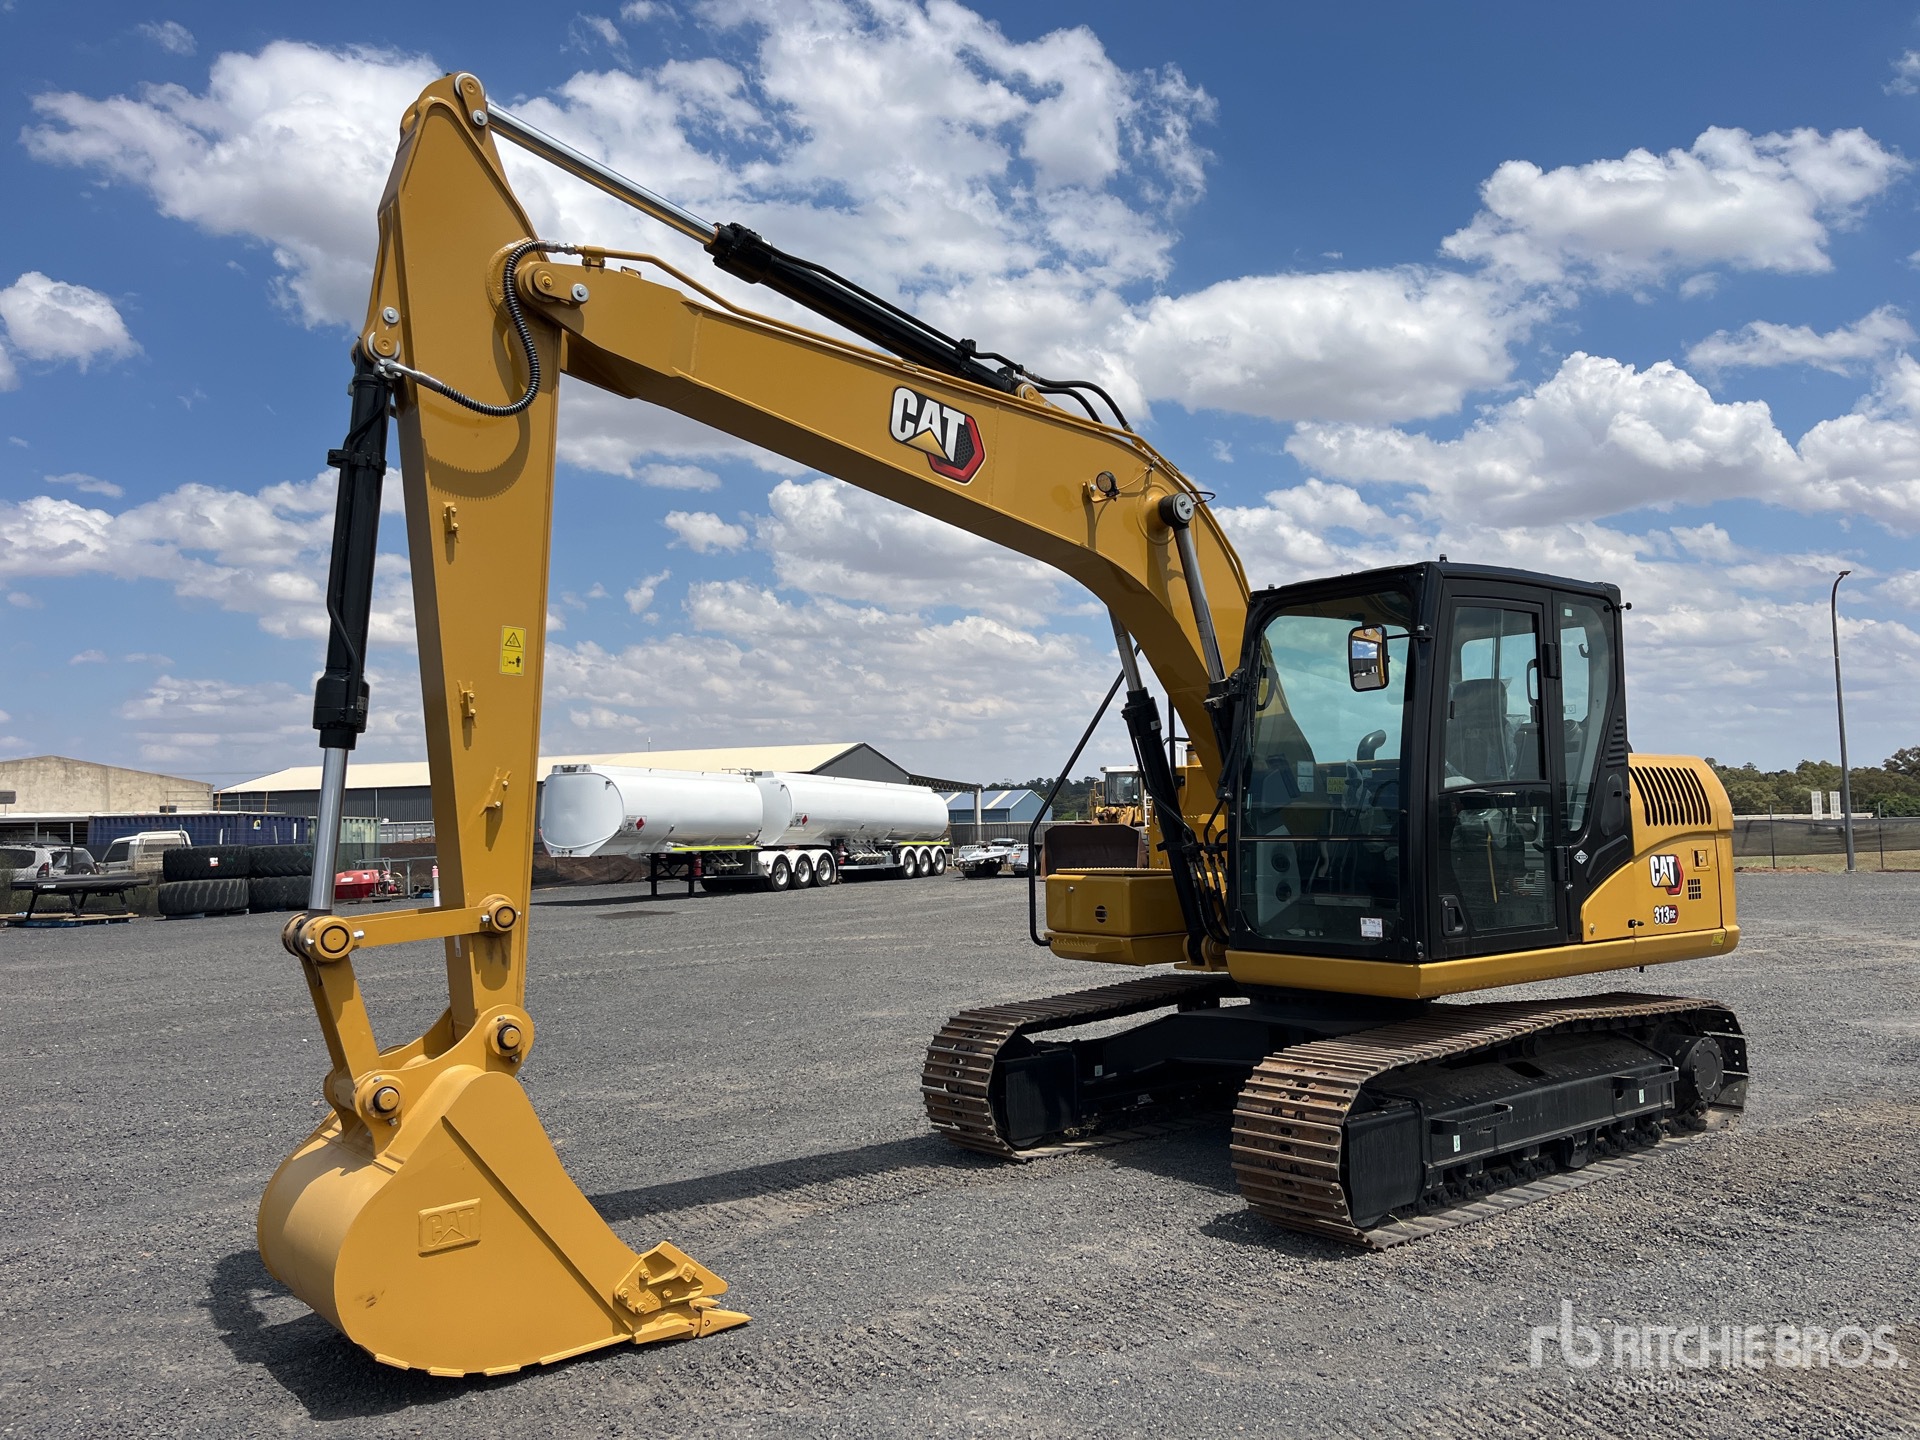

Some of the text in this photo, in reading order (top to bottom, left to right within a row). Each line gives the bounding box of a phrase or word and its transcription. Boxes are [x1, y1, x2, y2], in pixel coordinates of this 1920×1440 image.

[891, 387, 965, 462] CAT
[1650, 855, 1675, 887] CAT
[1654, 906, 1670, 923] 313
[421, 1207, 475, 1247] CAT
